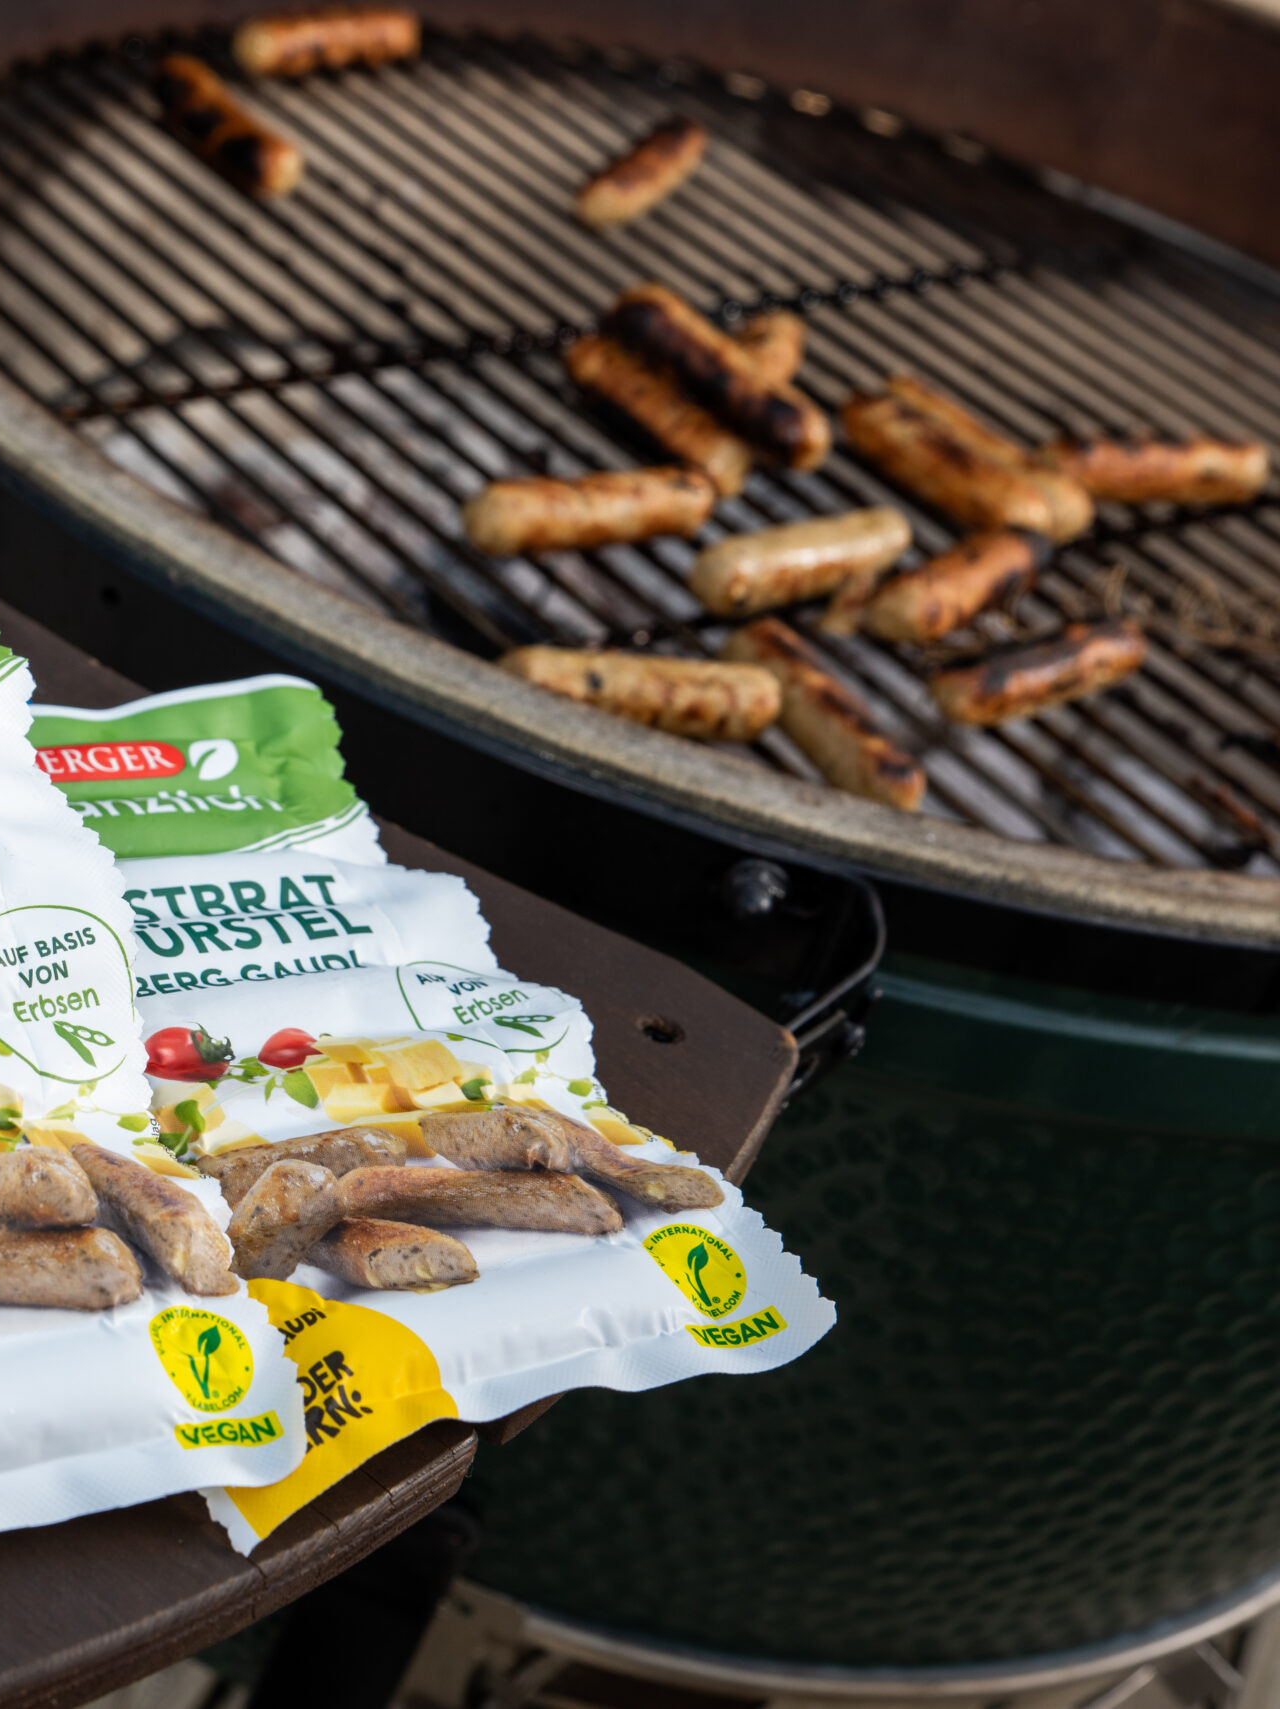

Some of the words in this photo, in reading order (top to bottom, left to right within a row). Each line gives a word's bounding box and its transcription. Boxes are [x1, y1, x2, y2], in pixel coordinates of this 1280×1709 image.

[35, 745, 176, 774] ERGER
[122, 875, 335, 924] STBRAT
[35, 926, 97, 959] BASIS
[134, 908, 373, 957] ÜRSTEL
[18, 960, 69, 989] VON
[13, 987, 100, 1024] Erbsen
[452, 989, 530, 1025] Erbsen
[650, 1226, 733, 1261] INTERNATIONAL
[161, 1308, 245, 1349] INTERNATIONAL
[691, 1312, 779, 1346] VEGAN
[296, 1350, 354, 1406] DER
[181, 1416, 276, 1445] VEGAN
